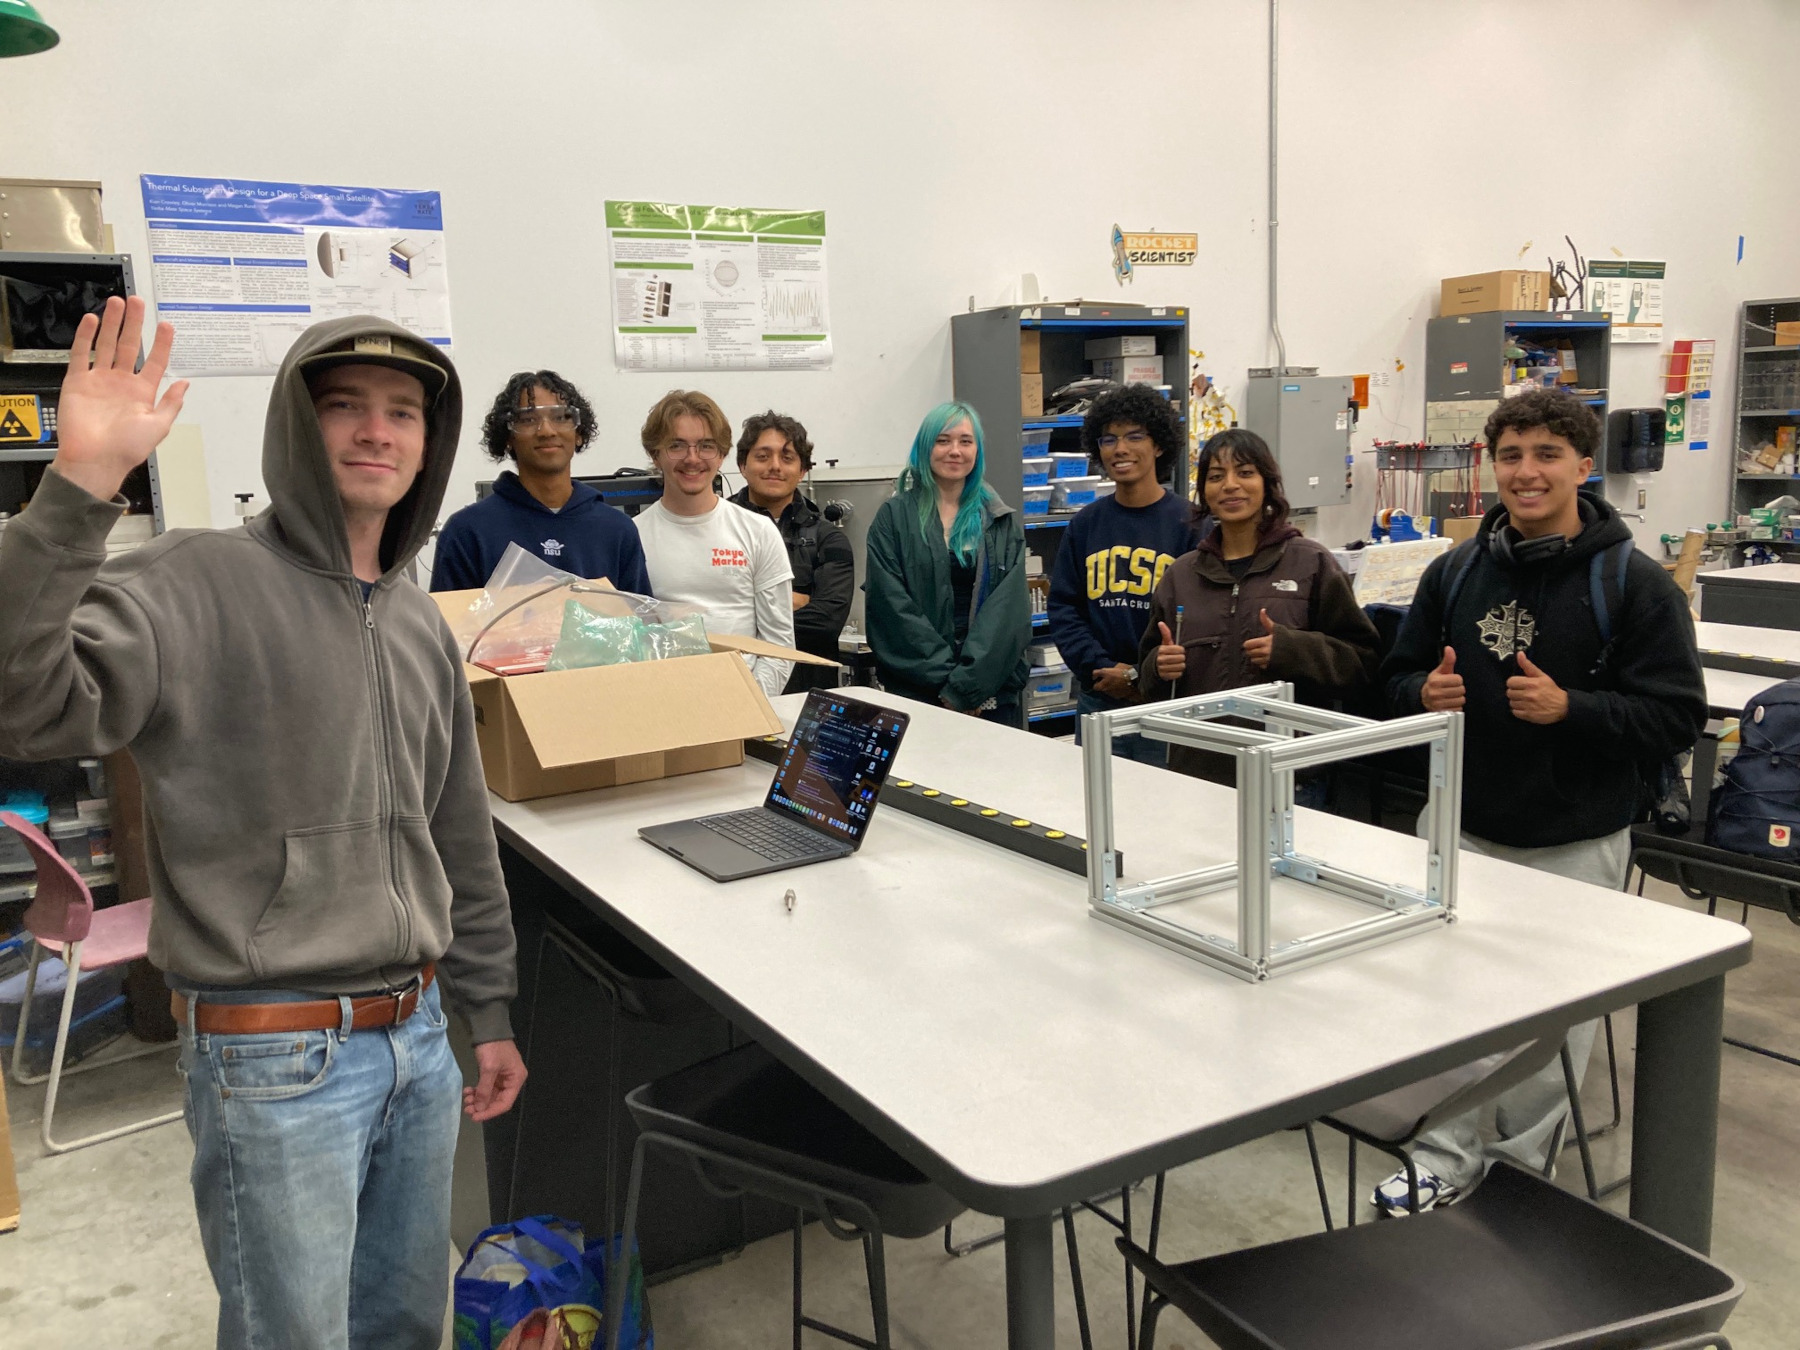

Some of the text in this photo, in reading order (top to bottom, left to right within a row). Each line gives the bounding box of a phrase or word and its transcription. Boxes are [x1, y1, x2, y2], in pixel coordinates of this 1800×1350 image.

[147, 182, 180, 192] Thermal
[182, 184, 225, 195] Subsystm
[228, 187, 255, 197] Design
[257, 188, 268, 196] for
[277, 190, 298, 200] Deep
[300, 192, 322, 201] Space
[324, 192, 345, 201] Small
[346, 194, 376, 202] Satellite
[1126, 236, 1195, 248] ROCKET
[1130, 251, 1195, 263] SCIENTIST
[544, 548, 561, 556] nsu
[712, 548, 744, 558] Tokyo
[712, 558, 748, 567] Market
[1098, 598, 1150, 610] SANTA CRU
